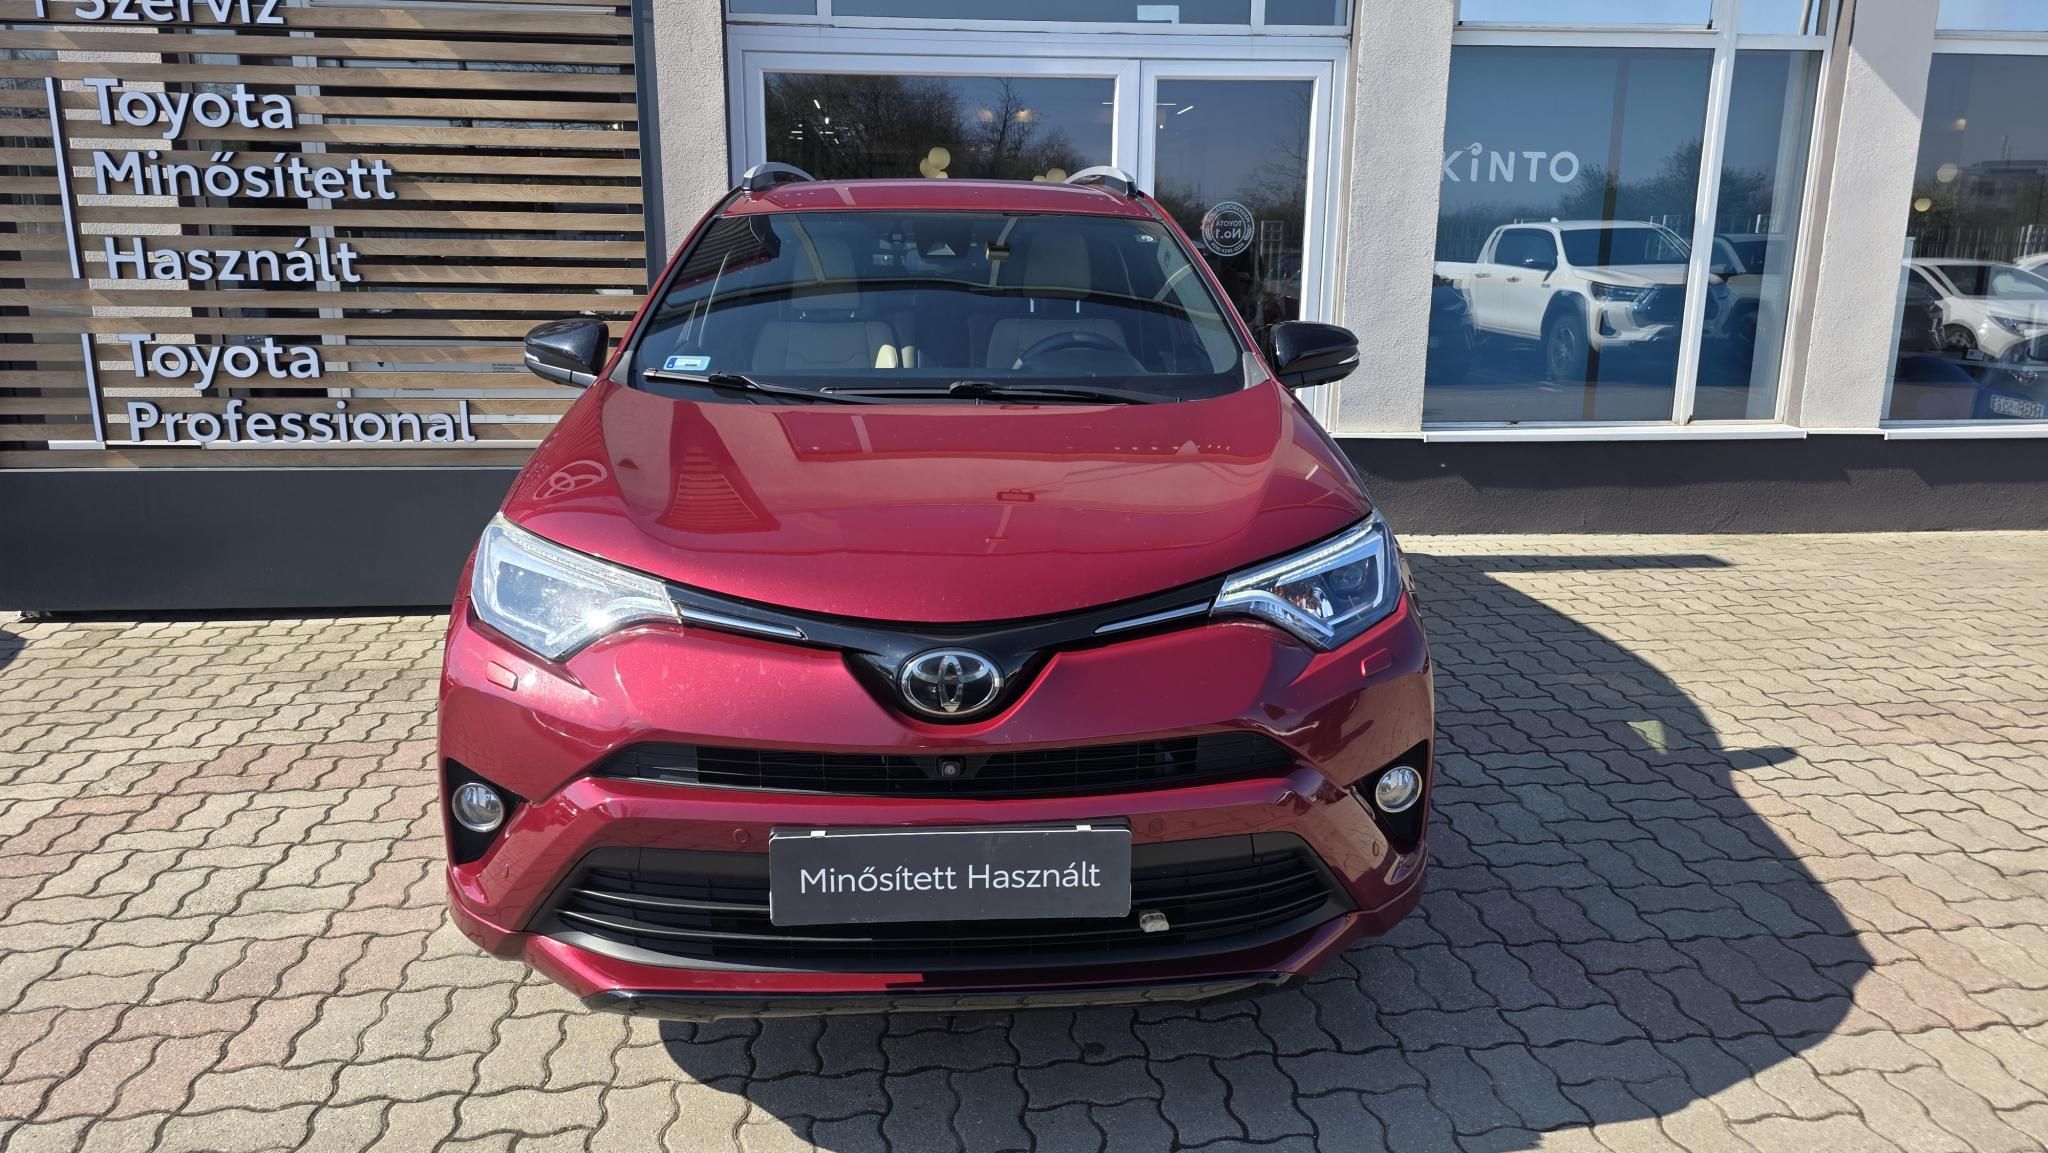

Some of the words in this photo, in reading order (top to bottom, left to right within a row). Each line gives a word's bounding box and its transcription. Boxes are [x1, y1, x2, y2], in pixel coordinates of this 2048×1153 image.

[83, 77, 295, 140] Toyota
[92, 150, 397, 200] Minősített
[105, 236, 361, 283] Használt
[117, 333, 322, 390] Toyota
[127, 399, 477, 443] Professional
[800, 865, 957, 893] Minősített
[968, 861, 1101, 888] Használt
